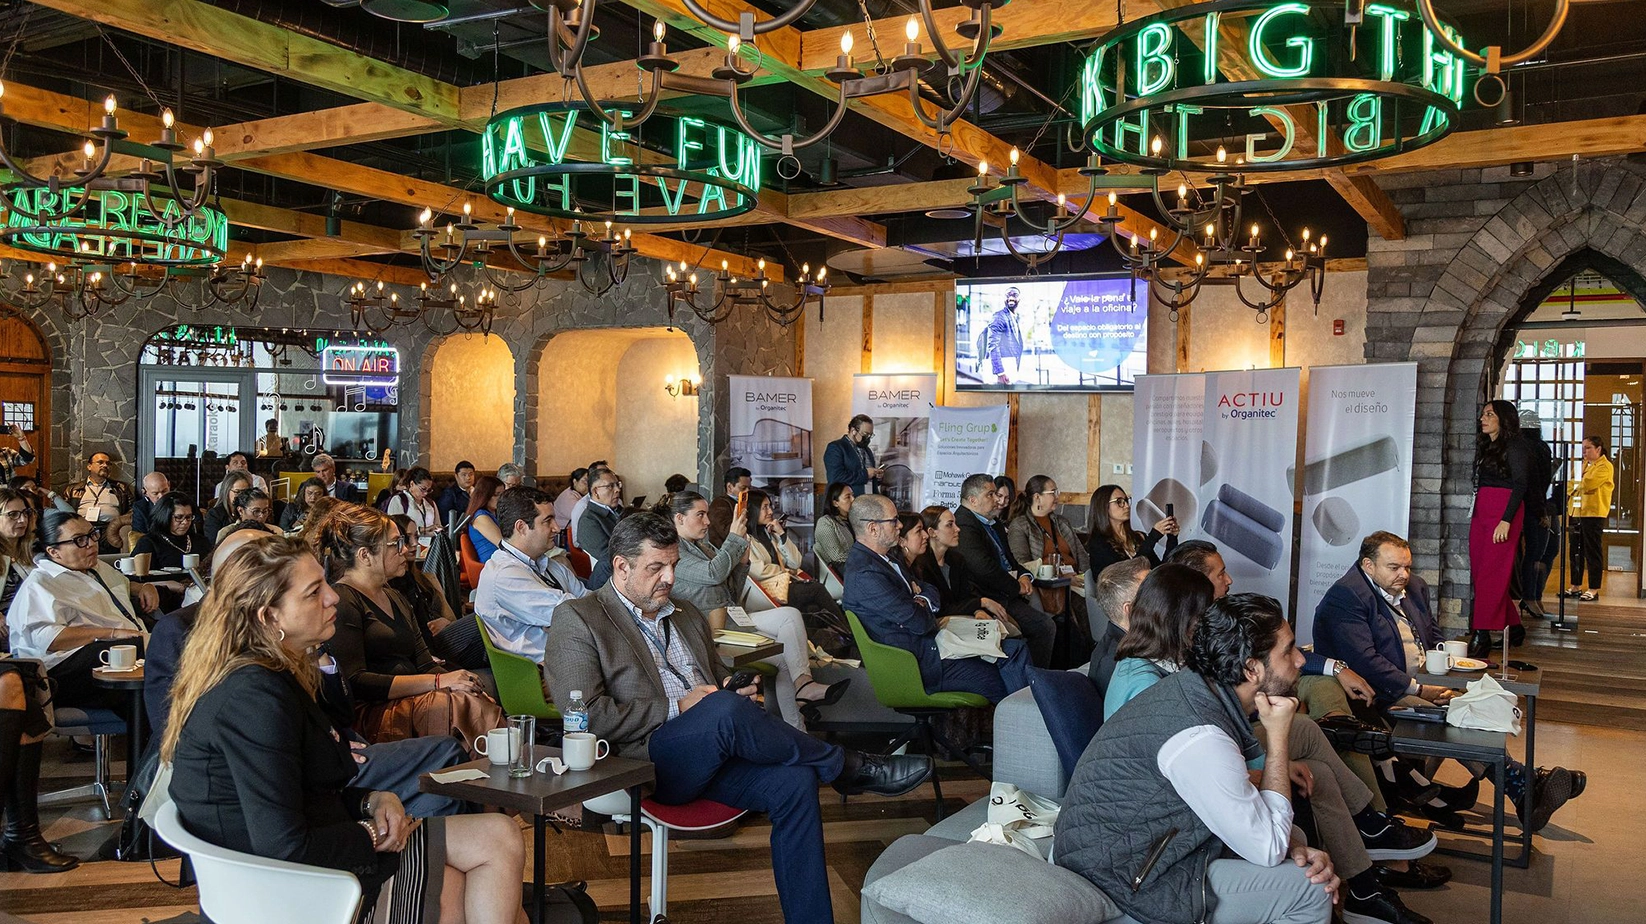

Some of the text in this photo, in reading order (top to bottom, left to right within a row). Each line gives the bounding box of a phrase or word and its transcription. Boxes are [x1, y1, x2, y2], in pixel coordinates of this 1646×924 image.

[1137, 4, 1313, 96] BIG
[482, 109, 761, 192] HAVE FUN
[9, 187, 228, 254] ARE READY
[1061, 305, 1081, 315] viaje
[1092, 305, 1100, 313] la
[1057, 324, 1069, 332] Del
[332, 357, 389, 373] ON AIR
[745, 391, 797, 404] BAMER
[868, 389, 921, 401] BAMER
[1217, 392, 1284, 408] ACTIU
[1331, 389, 1376, 399] Nos mueve
[760, 404, 787, 412] Organitec
[1345, 401, 1388, 414] el diseño
[1230, 409, 1276, 420] Organitec
[938, 422, 963, 435] Fling
[933, 489, 956, 498] Forma
[1316, 561, 1334, 569] Desde
